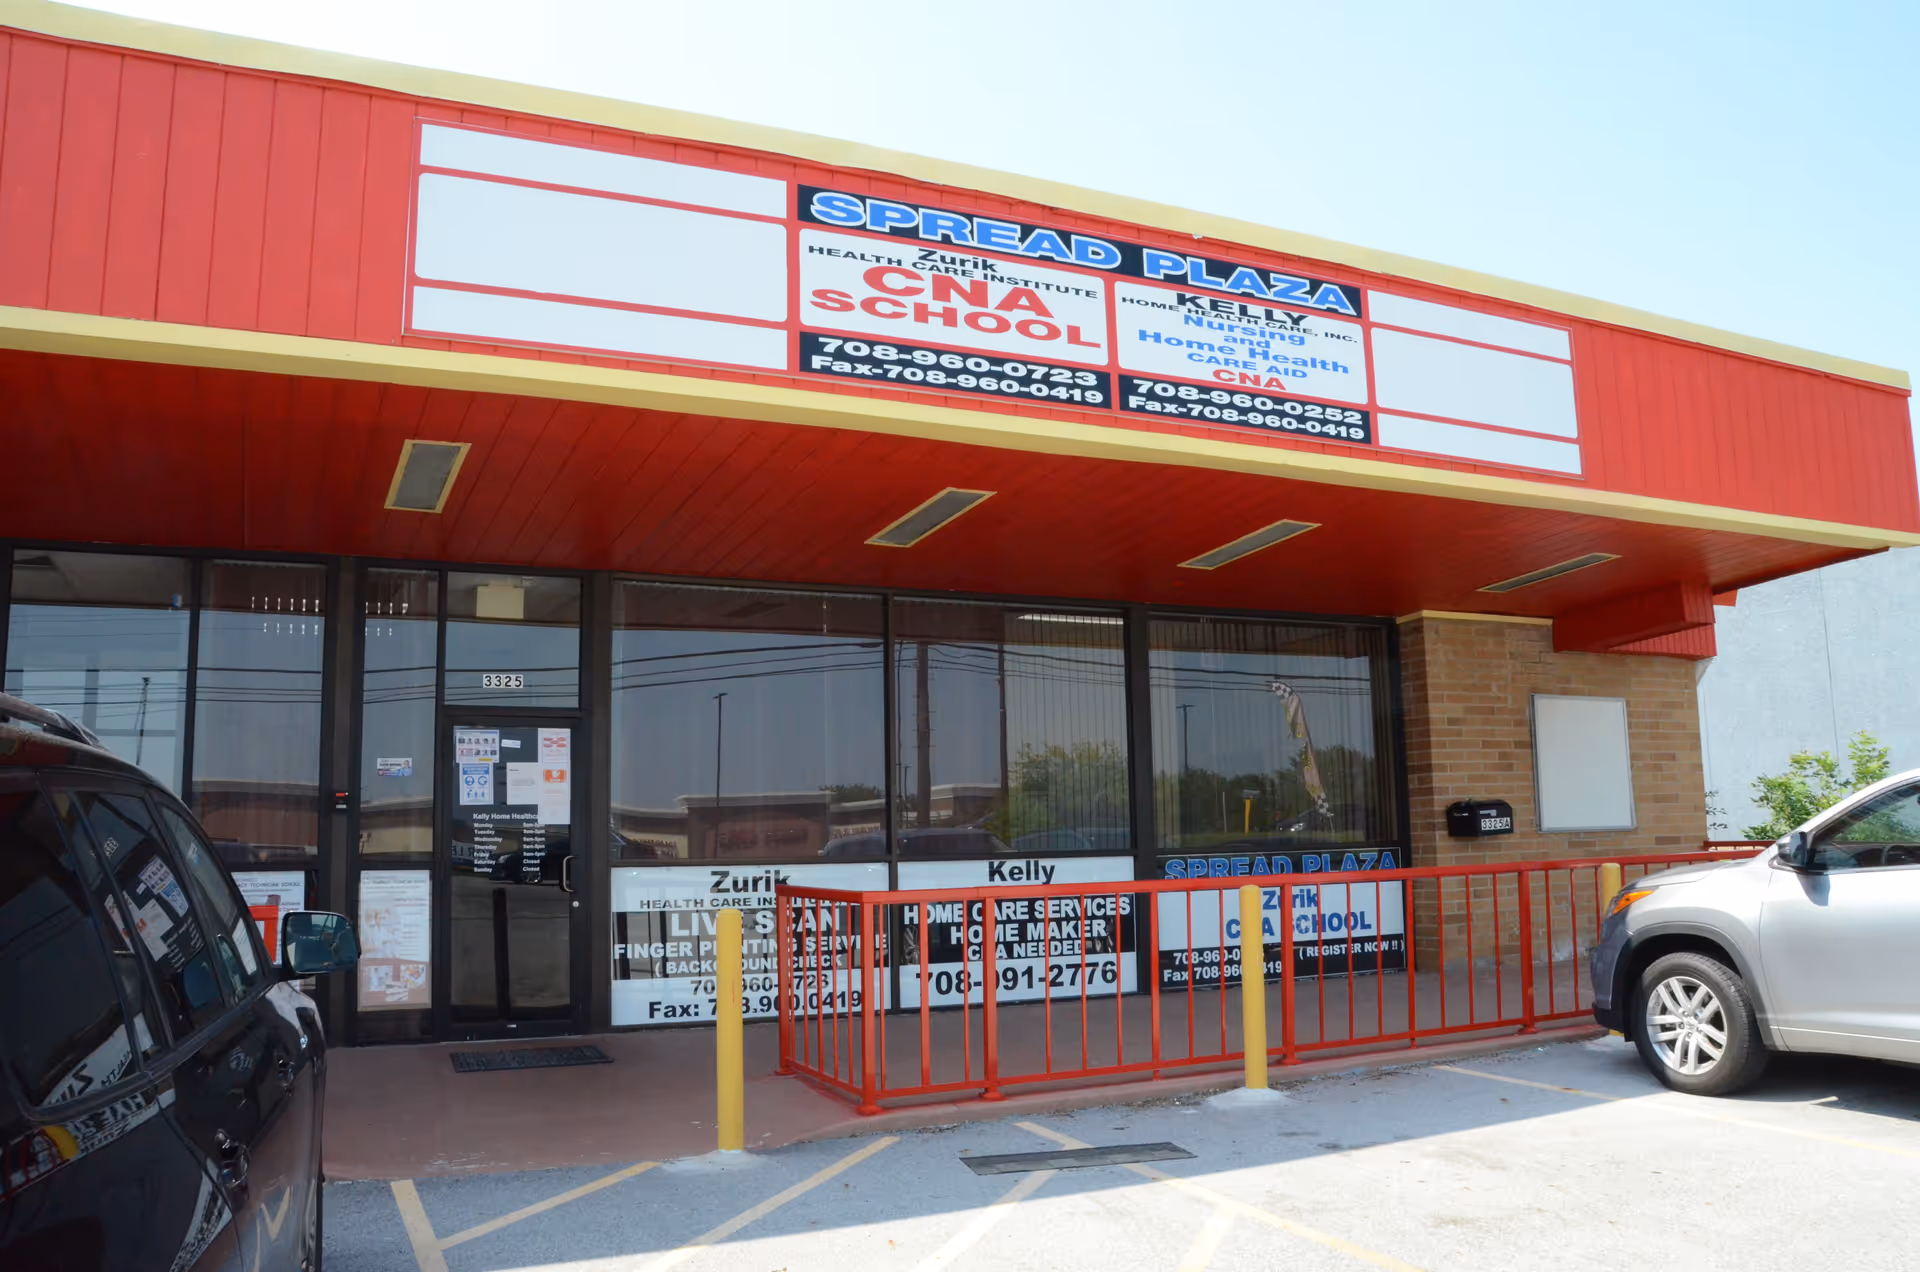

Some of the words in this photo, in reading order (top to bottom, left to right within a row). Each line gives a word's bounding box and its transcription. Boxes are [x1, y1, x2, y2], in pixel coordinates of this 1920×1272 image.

[810, 191, 1122, 269] SPREAD
[1143, 248, 1358, 316] PLAZA
[918, 247, 998, 273] Zurik
[808, 245, 903, 266] HEALTH
[911, 261, 974, 278] CARE
[983, 273, 1098, 299] INSTITUTE
[863, 266, 1054, 318] CNA
[810, 288, 1101, 348] SCHOOL
[1121, 296, 1181, 312] HOME
[1187, 308, 1259, 325] HEALTH
[1265, 321, 1318, 337] CARE,
[1324, 332, 1358, 343] INC.
[1176, 292, 1309, 327] KELLY
[1183, 314, 1306, 346] Nursing
[1223, 334, 1271, 349] and
[818, 336, 1098, 386] 708-960-0723
[1138, 329, 1236, 355] Home
[1248, 347, 1349, 374] Health
[1187, 353, 1257, 370] CARE
[1266, 364, 1308, 379] AID
[811, 355, 1103, 404] Fax-708-960-0419
[1212, 369, 1287, 391] CNA
[1133, 379, 1363, 425] 708-960-0252
[1128, 395, 1365, 440] Fax-708-960-0419
[484, 675, 522, 688] 3325
[1482, 818, 1510, 829] 3325A
[988, 859, 1055, 884] Kelly
[1165, 855, 1292, 880] SPREAD
[1302, 851, 1397, 874] PLAZA
[710, 870, 791, 894] Zurik
[639, 898, 704, 909] HEALTH
[709, 897, 753, 908] CARE
[1034, 897, 1130, 919] SERVICES
[1262, 888, 1318, 910] Zrik
[671, 911, 743, 937] LIV
[1027, 919, 1107, 941] MAKER
[1226, 916, 1275, 939] CA
[1291, 911, 1372, 935] CHOOL
[614, 941, 693, 959] FINGER
[699, 938, 798, 956] PTING
[805, 934, 887, 952] SERVIE
[967, 944, 1008, 960] CA
[1013, 940, 1082, 958] NEEDED
[1306, 943, 1363, 957] REGISTER
[1364, 940, 1389, 952] NOW
[666, 958, 778, 974] BACKUN
[915, 961, 1118, 995] 708-91-2776
[1163, 970, 1188, 982] Fax
[649, 1001, 699, 1019] Fax:
